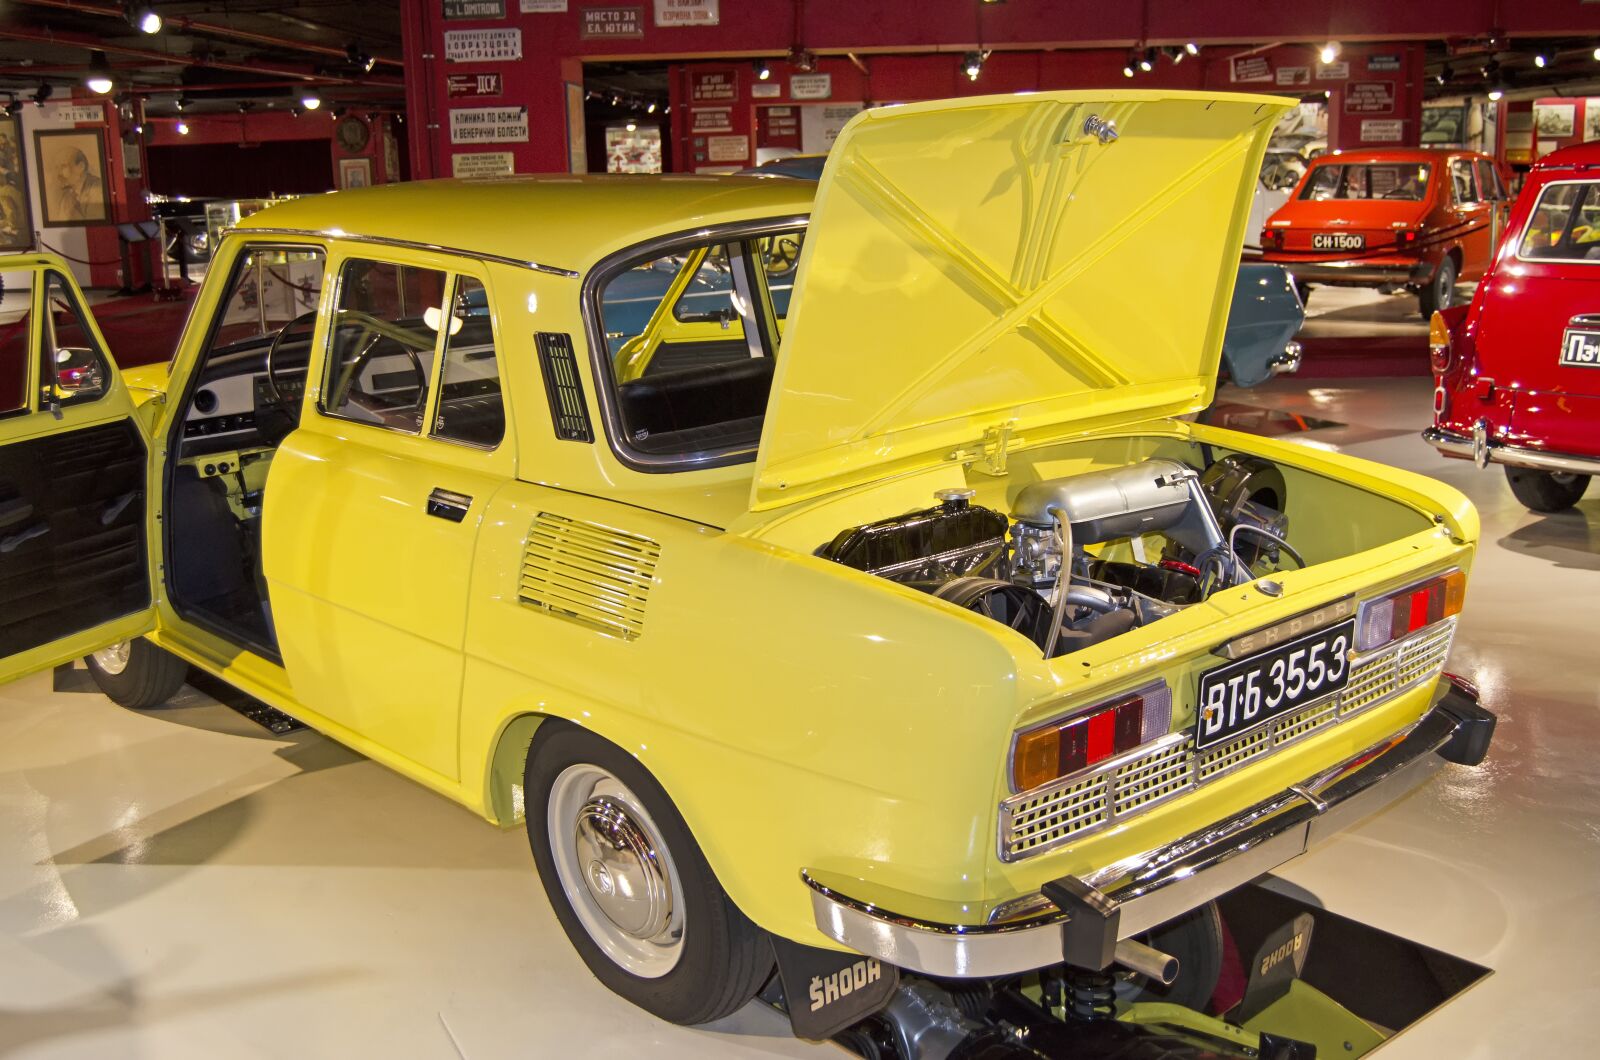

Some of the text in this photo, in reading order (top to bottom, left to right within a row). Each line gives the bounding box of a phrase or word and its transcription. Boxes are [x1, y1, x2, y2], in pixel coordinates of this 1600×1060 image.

[585, 11, 636, 22] МЯСТО ЗА
[477, 75, 497, 94] ДСК
[455, 111, 521, 125] КЛИНИКА ПО КОЖНИ
[453, 126, 527, 139] И ВЕНЕРИЧНИ БОЛЕСТИ
[1265, 635, 1348, 708] 3553
[809, 957, 880, 1012] ŠKODA
